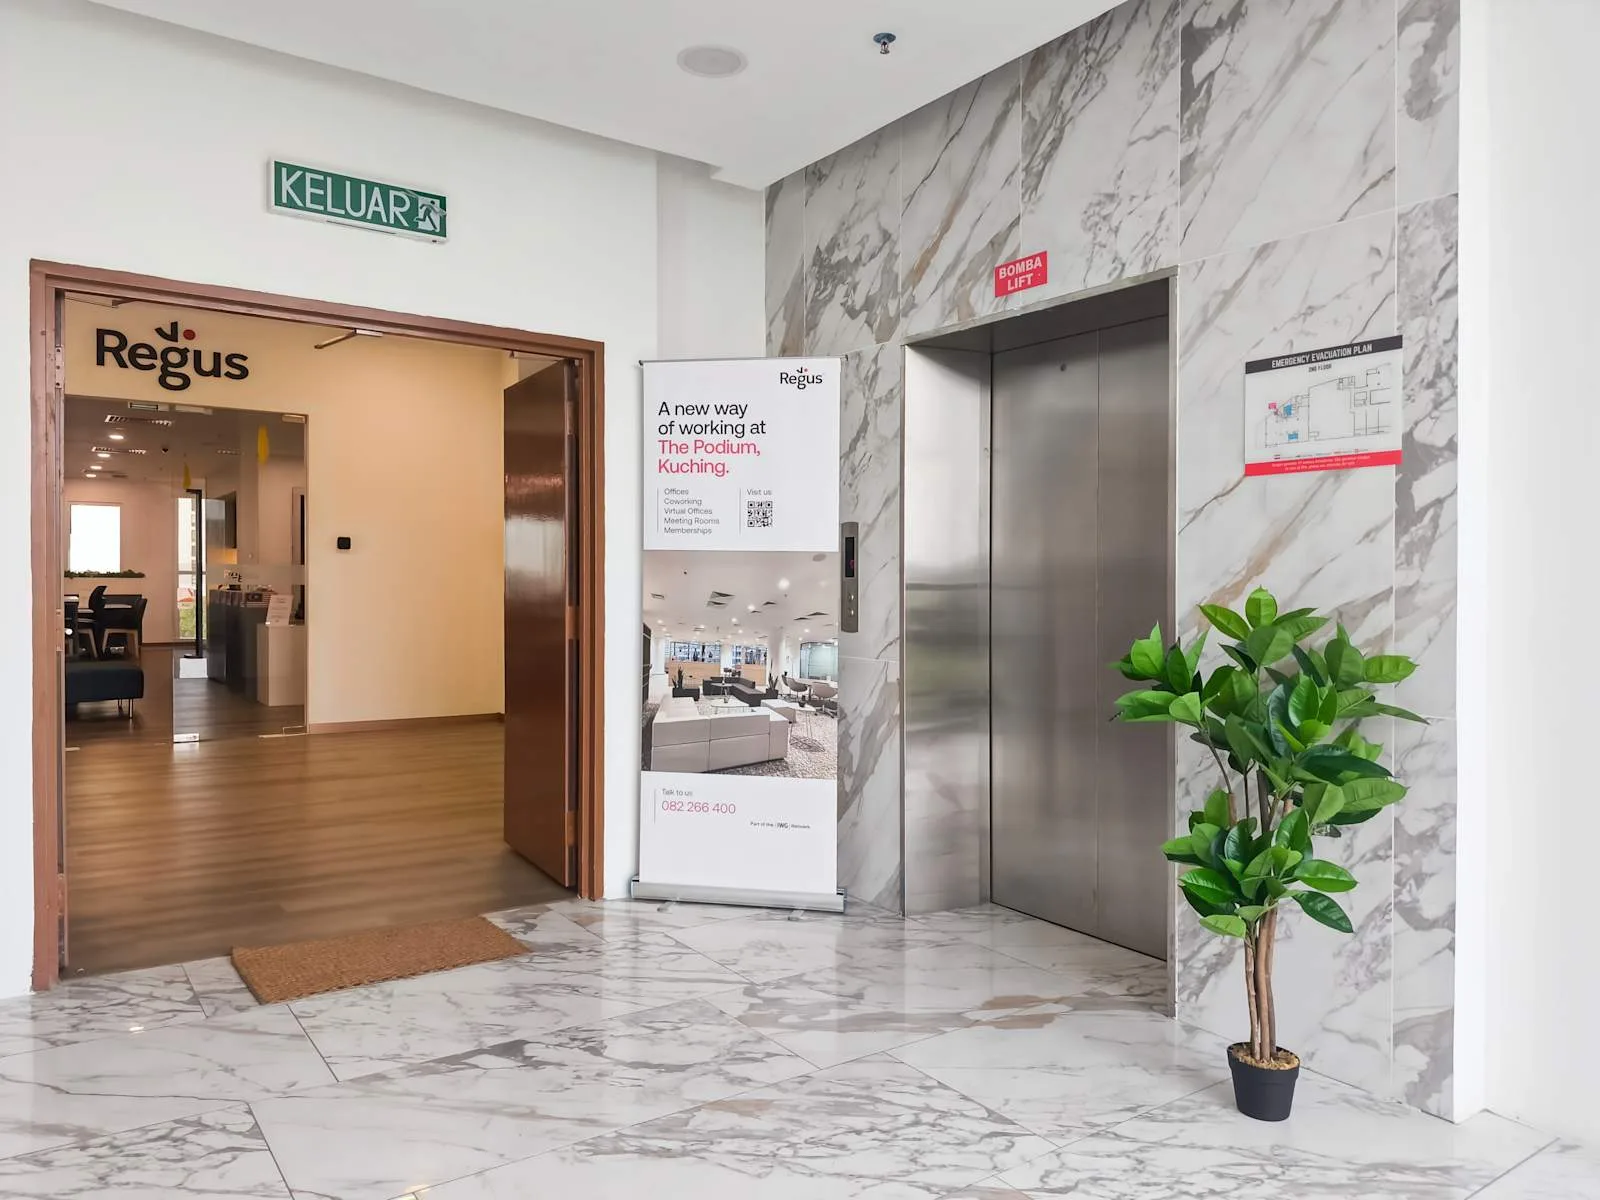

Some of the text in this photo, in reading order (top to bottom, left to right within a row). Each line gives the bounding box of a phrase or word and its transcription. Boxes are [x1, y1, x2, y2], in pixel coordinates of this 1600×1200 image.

[281, 167, 411, 227] KELUAR
[999, 256, 1042, 280] BOMBA
[1007, 273, 1034, 291] LIFT
[96, 321, 249, 391] Regus
[1271, 343, 1373, 369] EMERGENCY EVACUATION PLAN
[779, 366, 823, 390] Regus
[658, 401, 748, 418] A new way
[658, 421, 766, 438] of working at
[658, 440, 760, 456] The Podium,
[658, 459, 730, 478] Kuching.
[663, 498, 702, 506] Coworking
[663, 507, 713, 515] Virtual Offices
[663, 517, 720, 525] Meeting Rooms
[663, 527, 712, 535] Memberships
[662, 788, 675, 796] Talk
[676, 789, 684, 797] to
[662, 800, 736, 814] 082 266 400
